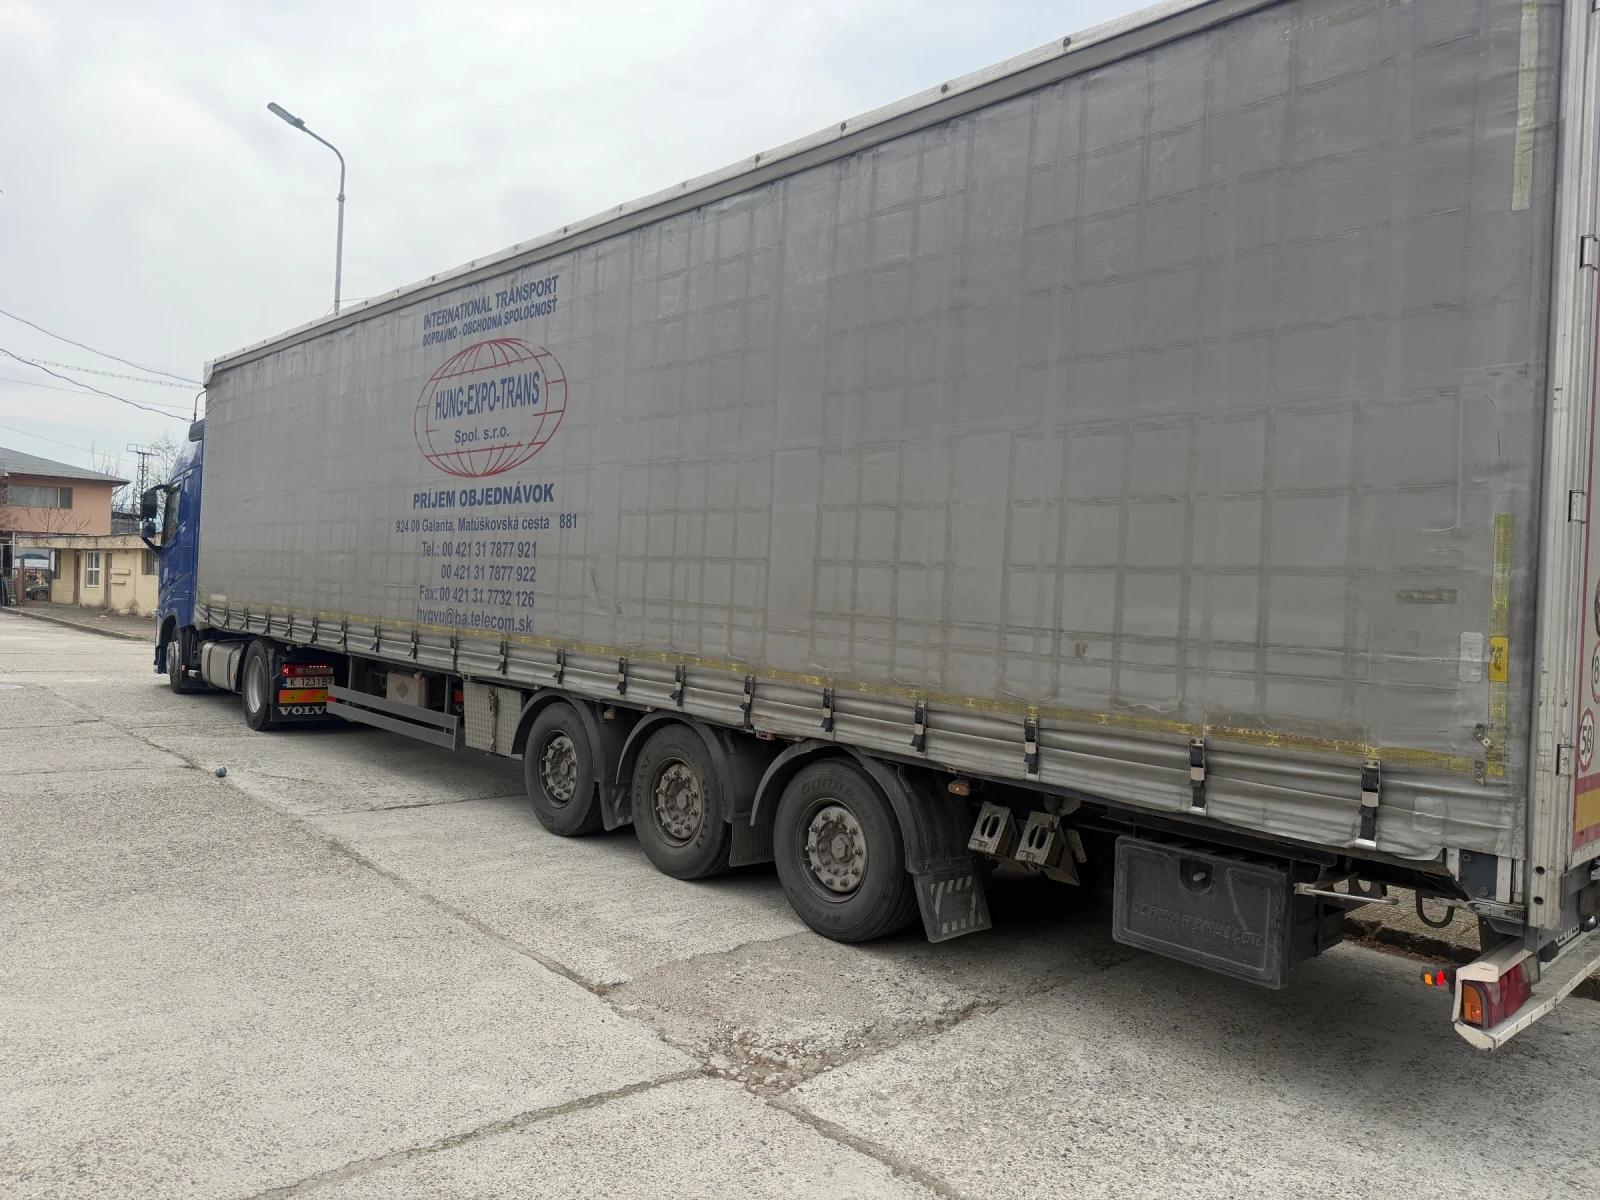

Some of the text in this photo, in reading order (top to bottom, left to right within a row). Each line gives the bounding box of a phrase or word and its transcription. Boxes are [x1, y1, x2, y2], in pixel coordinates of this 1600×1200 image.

[423, 274, 559, 331] INTERNATIONAL TRANSPORT
[422, 326, 458, 348] DOPRAVNO
[462, 310, 502, 337] OBCHODNÁ
[435, 370, 540, 421] HUNG-EXPO-TRANS
[454, 427, 510, 446] Spol. s.r.o.
[413, 481, 555, 510] PRÍJEM OBJEDNÁVOK
[395, 513, 577, 534] 924 00 Galanta, Matúškovská cesta 881
[422, 540, 537, 558] Tel.: 00 421 31 7877 921
[441, 564, 536, 582] 00 421 31 7877 922
[419, 585, 535, 608] Fax: 00 421 31 7732 126
[290, 677, 296, 687] K
[302, 677, 320, 687] 1231
[278, 705, 327, 716] VOLV
